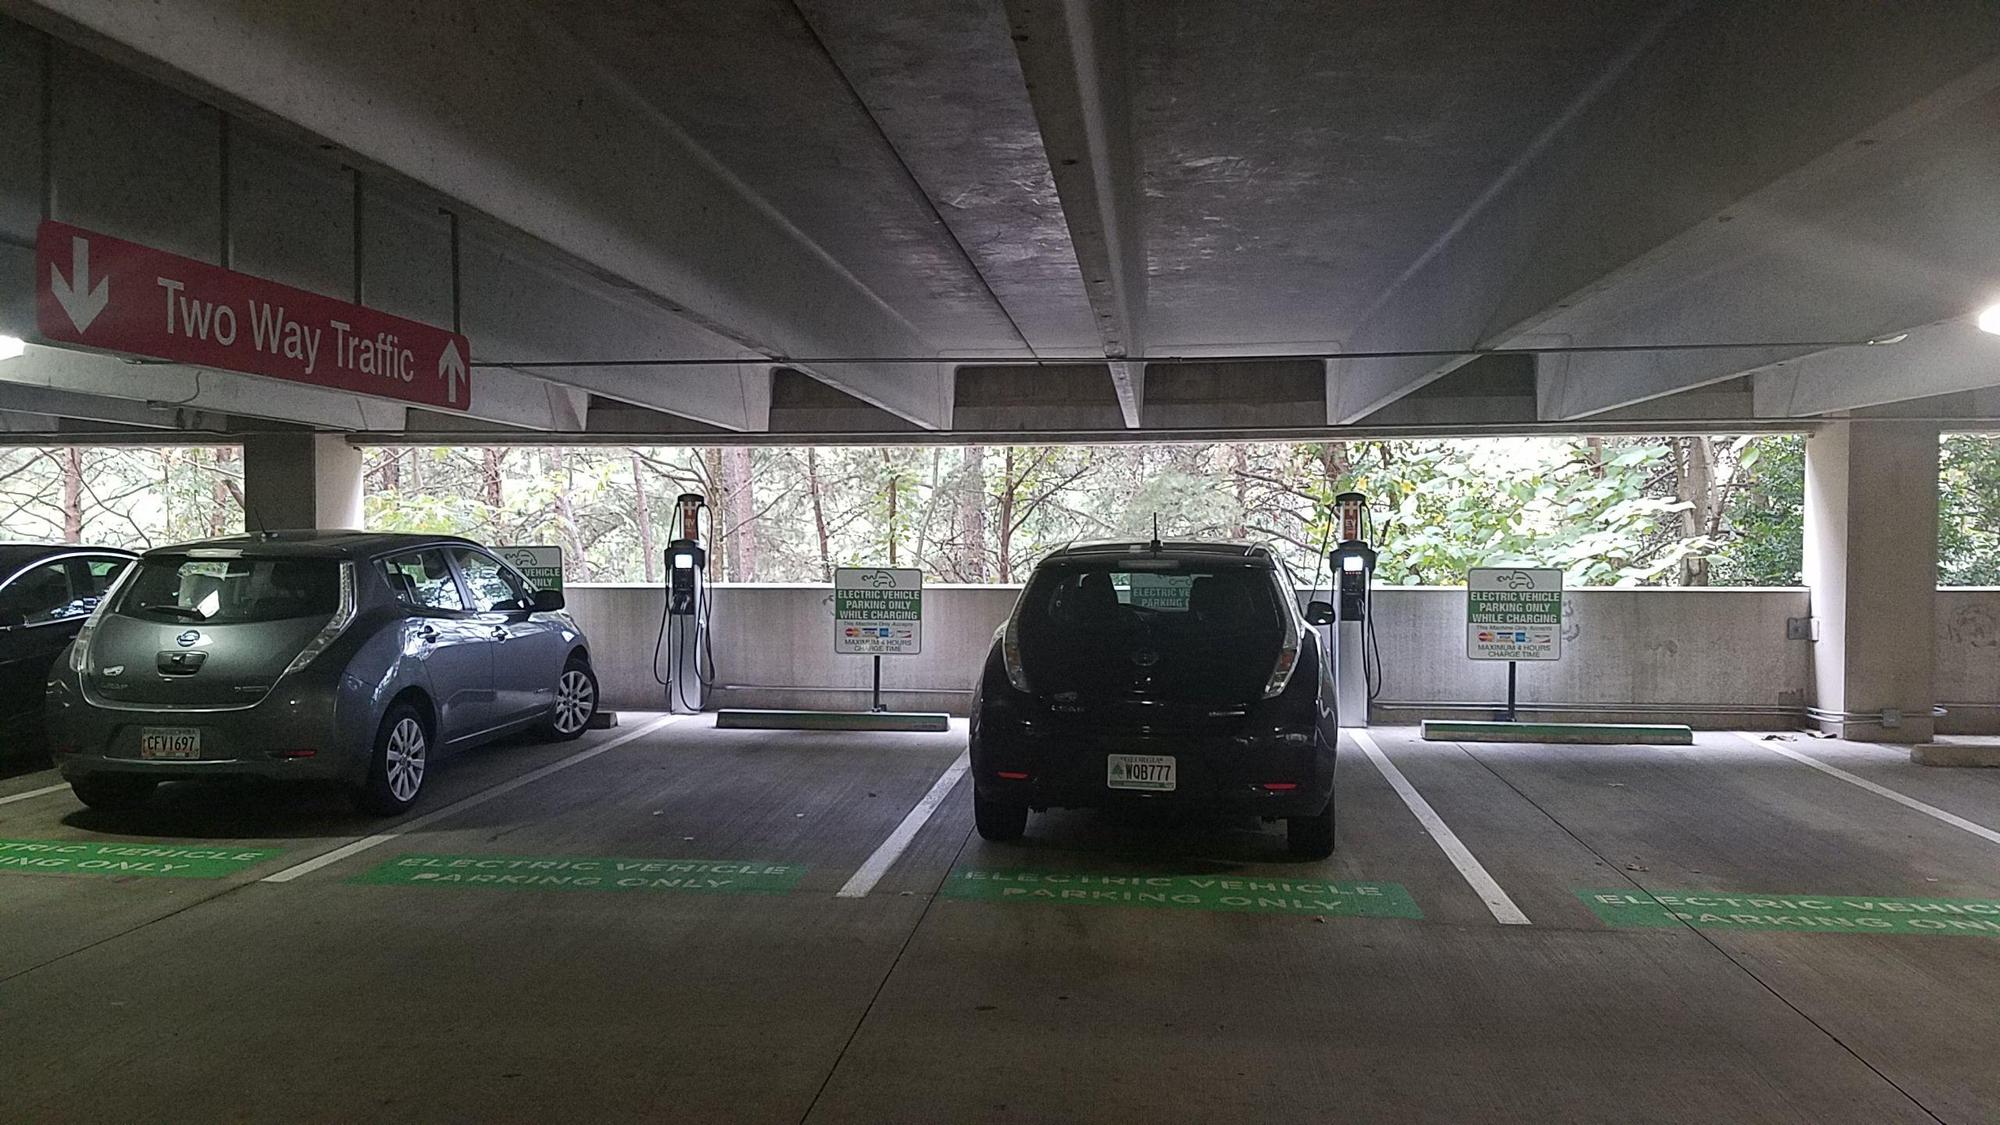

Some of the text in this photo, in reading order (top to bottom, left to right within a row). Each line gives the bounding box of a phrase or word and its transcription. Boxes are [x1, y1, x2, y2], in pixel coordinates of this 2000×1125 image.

[157, 276, 414, 383] Two Way Traffic
[524, 568, 560, 577] VEHICLE
[838, 590, 920, 600] ELECTRIC VEHICLE
[1133, 588, 1177, 597] ELECTRIC
[1471, 592, 1560, 602] ELECTRIC VEHICLE
[846, 600, 911, 610] PARKING ONLY
[1142, 598, 1183, 607] PARKING
[1480, 603, 1550, 612] PARKING ONLY
[840, 610, 917, 620] WHILE CHARGING
[1472, 613, 1557, 623] WHILE CHARGING
[148, 735, 195, 751] CFV1697
[0, 842, 265, 861] TRIC VEHICLE
[77, 860, 190, 873] ONLY
[398, 858, 790, 875] ELECTRIC VEHICLE
[411, 873, 733, 888] PARKING ONLY
[965, 871, 1383, 896] ELECTRIC VEHICLE
[1003, 888, 1342, 910] PARKING ONLY
[1594, 894, 2000, 914] ELECTRIC VEHIC
[1664, 912, 1893, 929] PARKING
